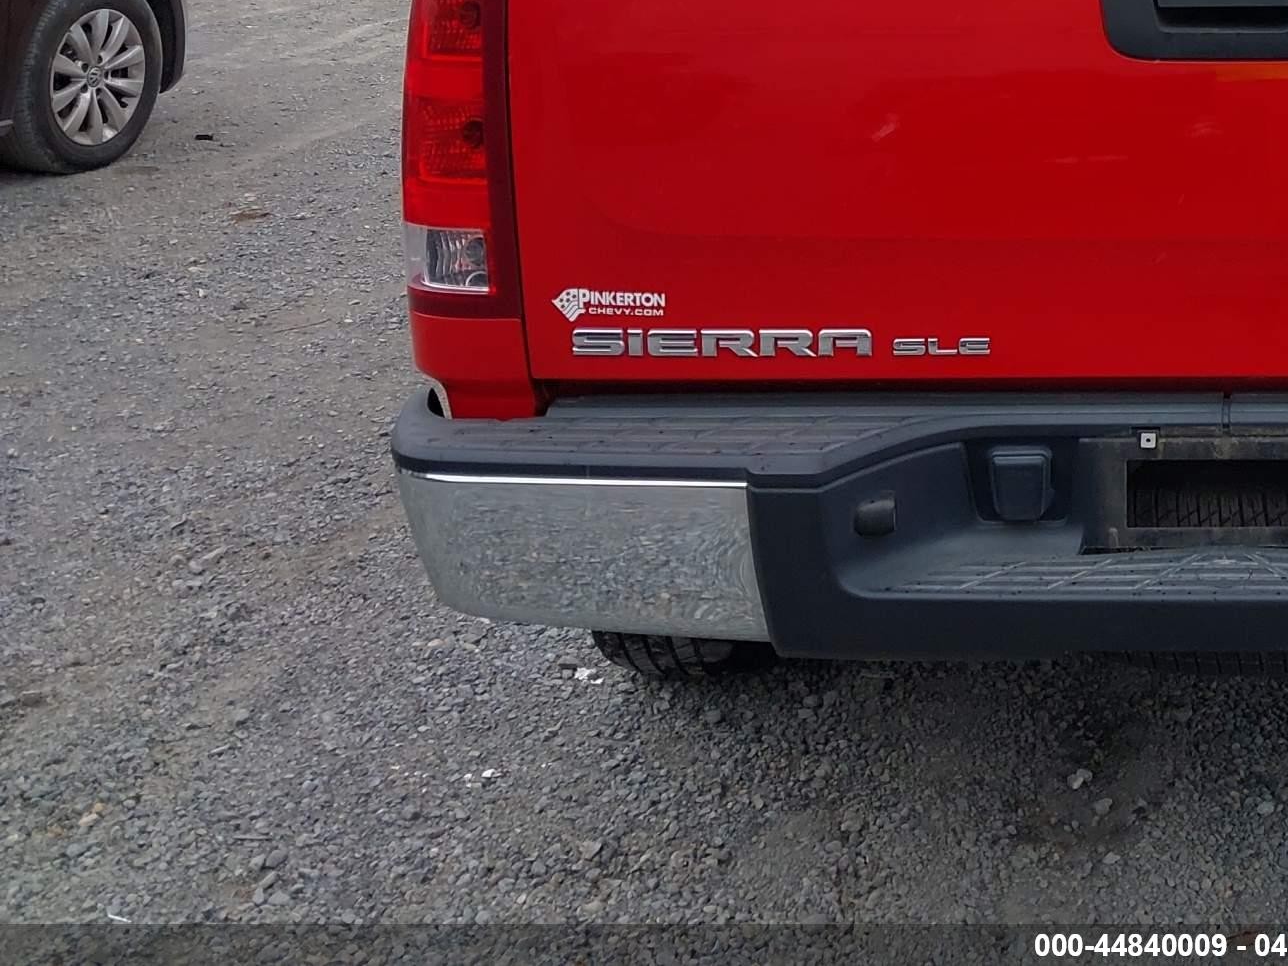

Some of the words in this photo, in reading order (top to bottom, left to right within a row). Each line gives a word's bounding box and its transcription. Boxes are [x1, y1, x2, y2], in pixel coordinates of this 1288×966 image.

[579, 289, 666, 308] PINKERTON
[588, 307, 664, 317] CHEVY.COM
[571, 327, 873, 357] SIERRA
[892, 337, 991, 356] SLE
